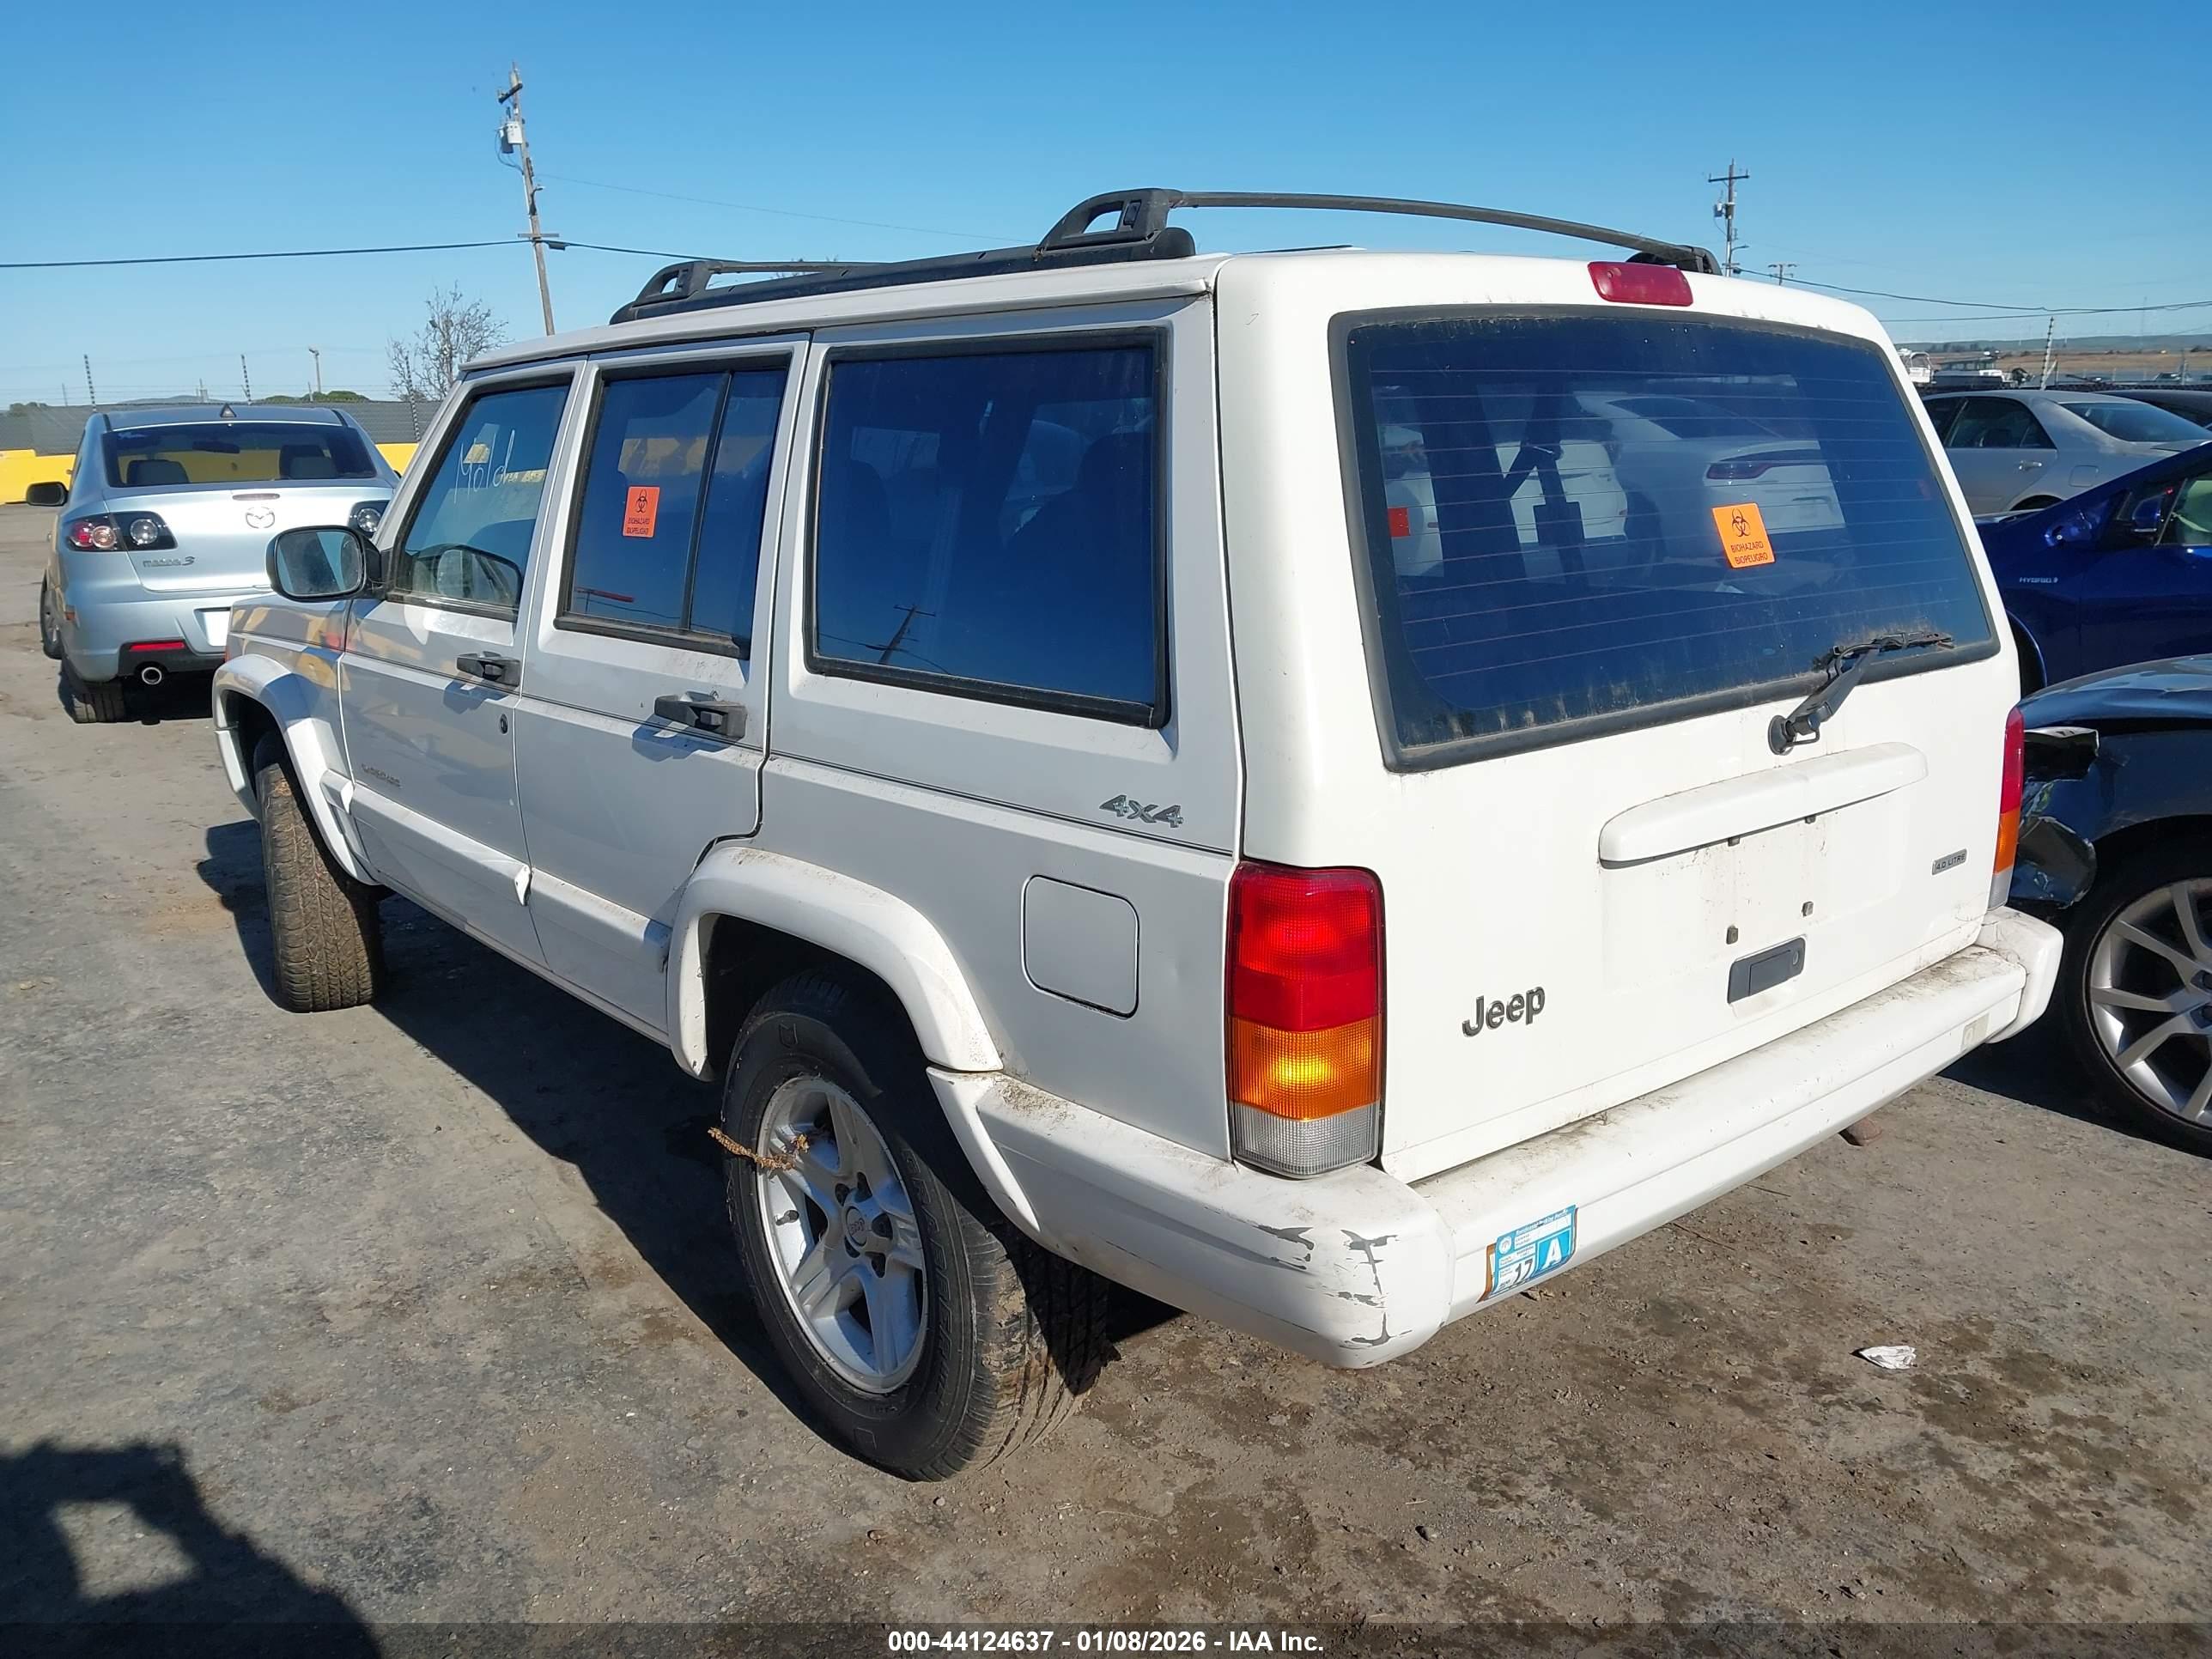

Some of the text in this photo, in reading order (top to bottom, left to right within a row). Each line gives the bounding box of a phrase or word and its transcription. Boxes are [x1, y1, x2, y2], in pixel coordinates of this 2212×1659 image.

[1730, 541, 1764, 553] BIOHAZARD
[1735, 552, 1768, 564] BIOPELIGRO
[1462, 986, 1546, 1037] Jeep
[1513, 1258, 1534, 1285] 17
[1540, 1237, 1563, 1271] A
